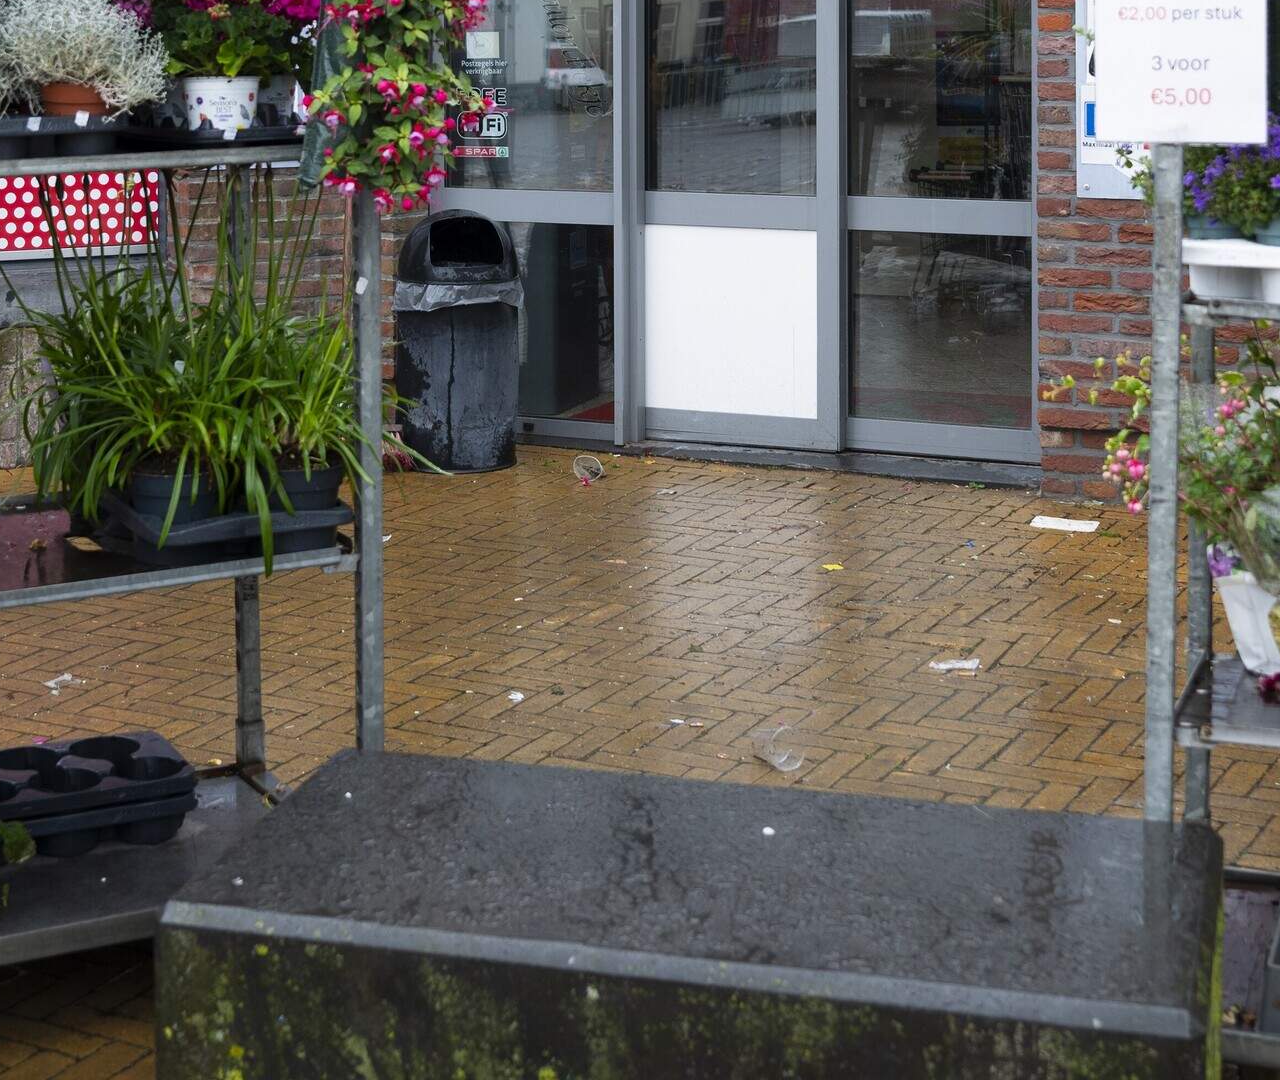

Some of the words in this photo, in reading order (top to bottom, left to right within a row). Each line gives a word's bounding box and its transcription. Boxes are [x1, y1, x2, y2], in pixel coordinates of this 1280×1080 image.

[1118, 6, 1167, 21] €2,00
[1171, 7, 1200, 22] per
[1205, 6, 1242, 20] stuk
[461, 60, 494, 68] Postzegels
[1151, 56, 1162, 71] 3
[1167, 57, 1210, 71] voor
[1151, 88, 1212, 106] €5,00
[465, 148, 496, 156] SPAR
